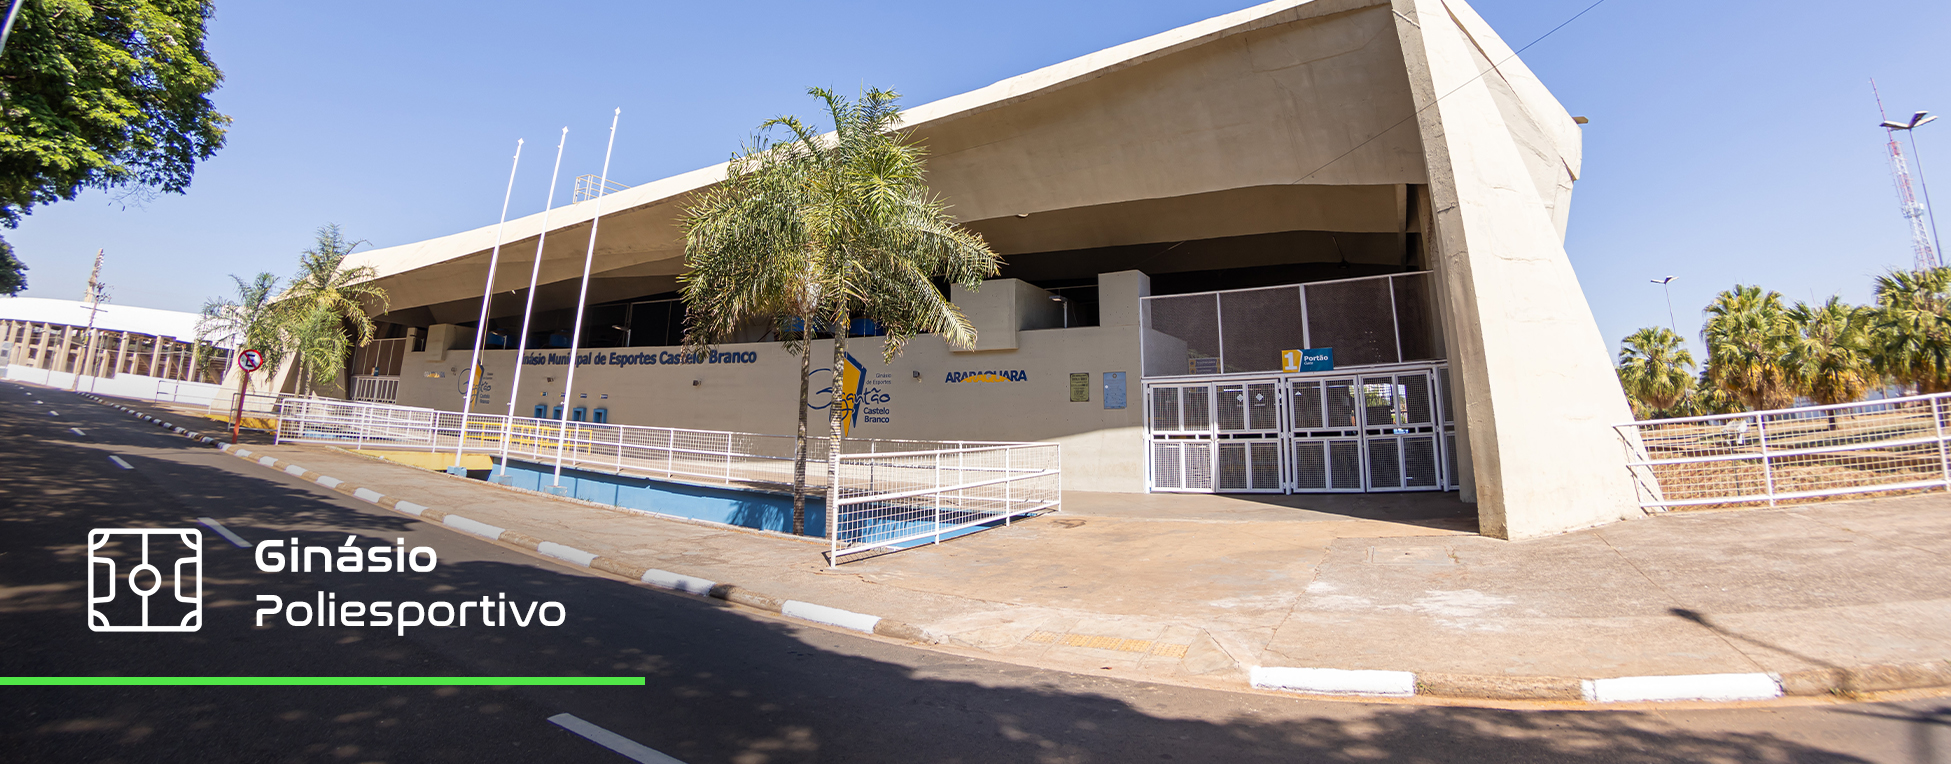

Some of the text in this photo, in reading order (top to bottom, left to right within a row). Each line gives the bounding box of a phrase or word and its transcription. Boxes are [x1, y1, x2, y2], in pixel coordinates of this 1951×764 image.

[516, 350, 757, 368] inásio Muniipal de Esportes Castelo Branco
[1284, 352, 1298, 370] 1
[1303, 354, 1329, 362] Portão
[945, 369, 1028, 383] ARARAQUARA
[863, 407, 890, 415] Castelo
[864, 415, 890, 423] Branco
